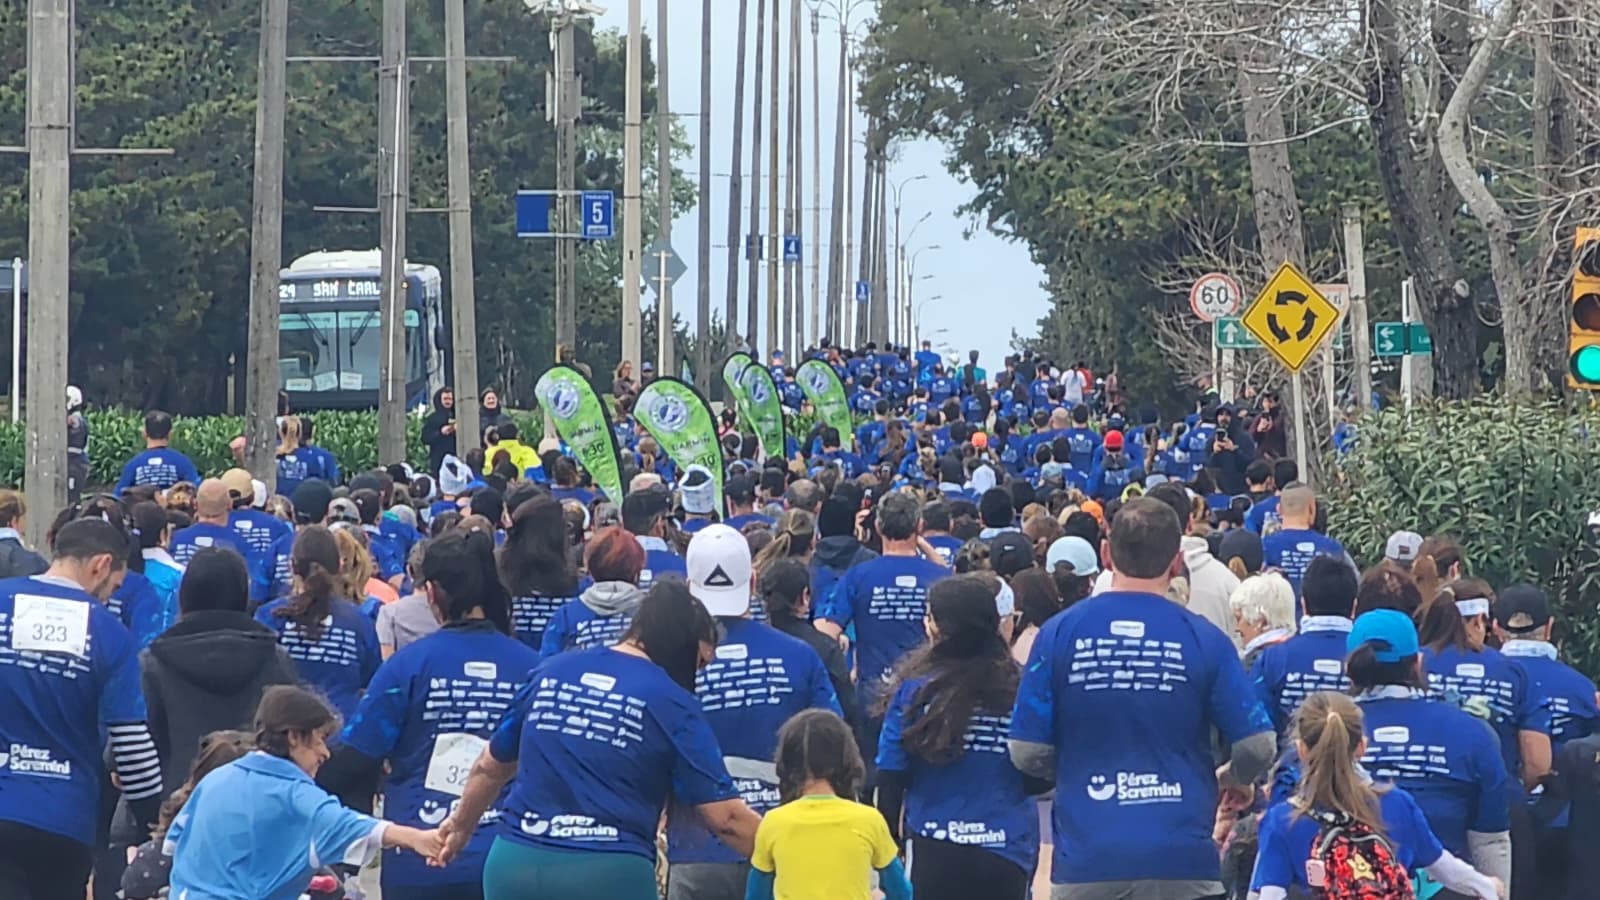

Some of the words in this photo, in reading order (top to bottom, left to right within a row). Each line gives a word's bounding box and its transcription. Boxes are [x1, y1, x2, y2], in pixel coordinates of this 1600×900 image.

[592, 201, 603, 224] 5
[313, 280, 339, 297] SAN
[1201, 286, 1229, 305] 60
[31, 622, 68, 643] 323
[10, 743, 50, 760] Pérez
[9, 756, 71, 775] Scremini
[1117, 771, 1158, 786] Pérez
[1117, 782, 1182, 800] Scremini
[948, 820, 986, 834] Pérez
